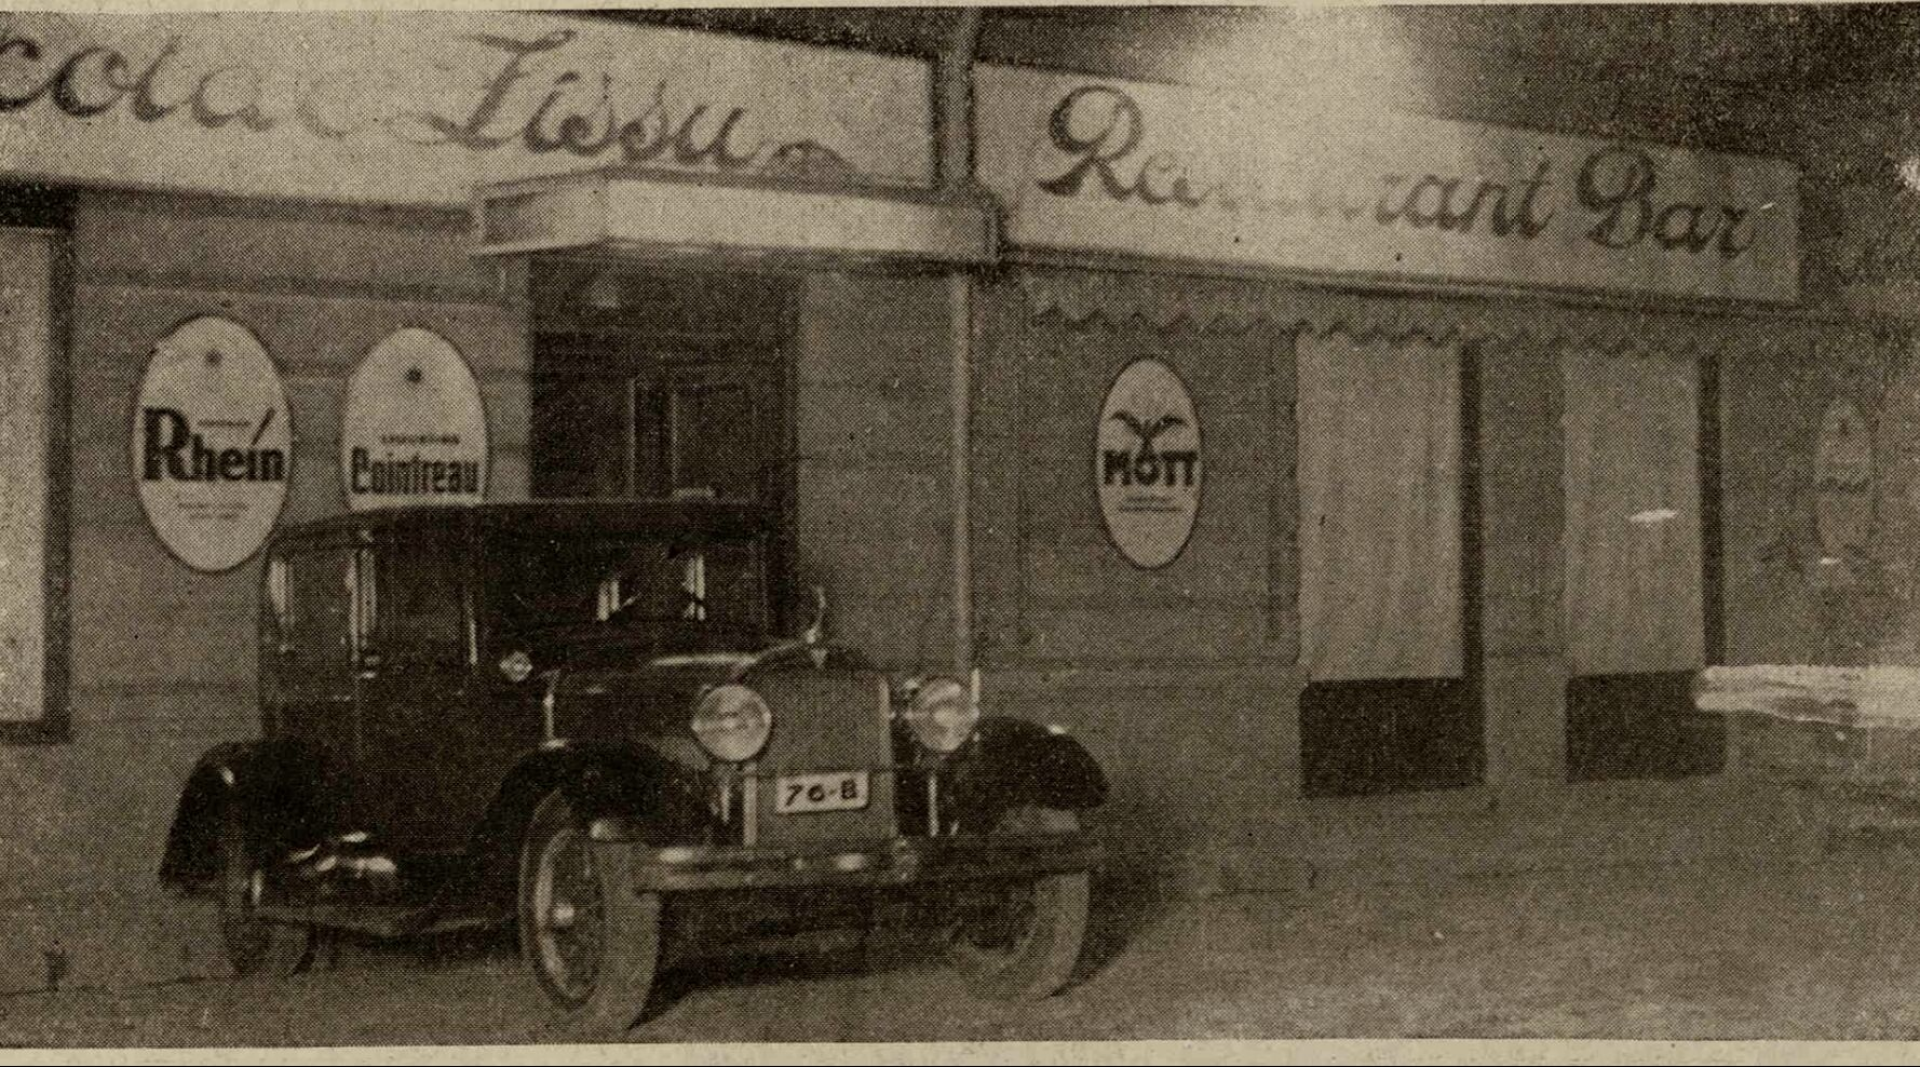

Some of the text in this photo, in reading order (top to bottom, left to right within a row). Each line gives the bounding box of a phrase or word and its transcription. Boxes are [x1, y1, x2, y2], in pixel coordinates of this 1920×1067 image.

[1036, 85, 1757, 259] Resrant Bar
[142, 407, 285, 482] Rhein
[350, 447, 479, 494] Cointreau
[1104, 451, 1199, 486] MOTT
